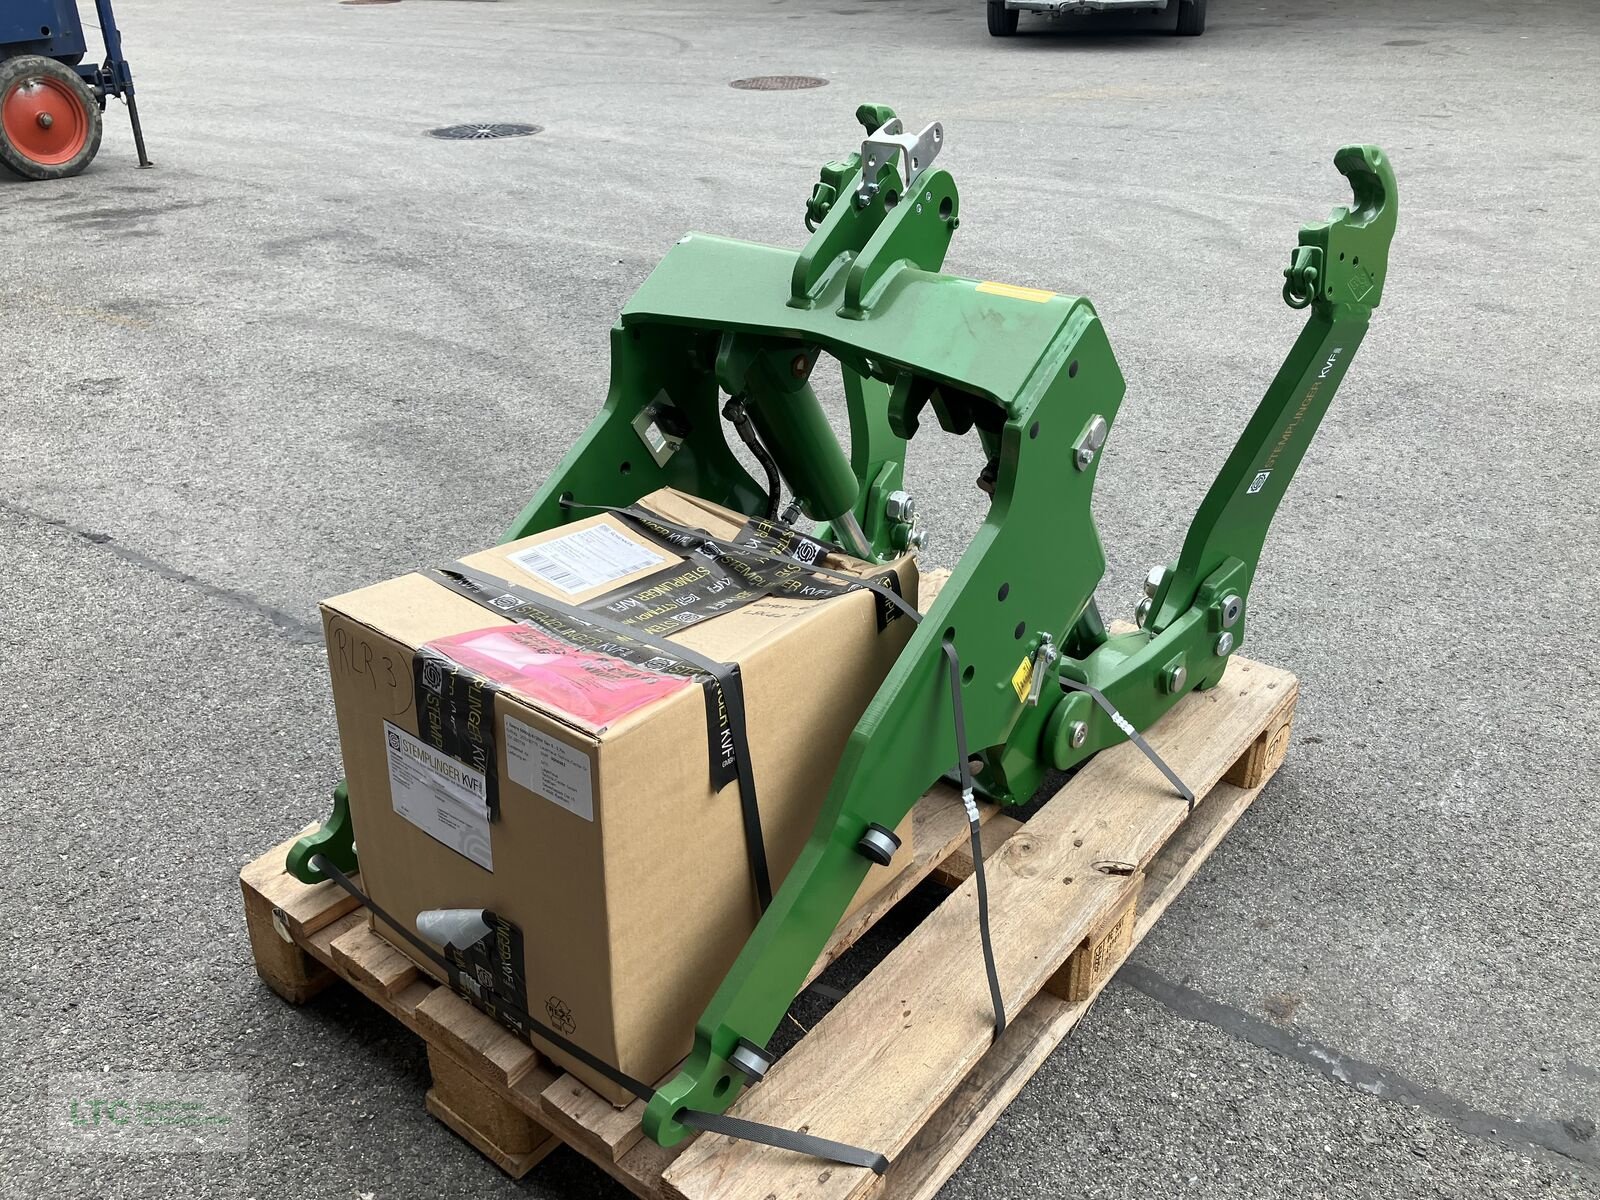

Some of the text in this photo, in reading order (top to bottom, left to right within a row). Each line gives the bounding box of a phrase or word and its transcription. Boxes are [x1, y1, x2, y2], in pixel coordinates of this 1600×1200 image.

[1264, 353, 1338, 468] STEMPLINGER KVF
[634, 566, 711, 601] STEMPLINGER
[515, 606, 604, 647] STEMPLINGER
[720, 728, 735, 758] KVF
[402, 738, 461, 783] STEMPLINGER
[461, 772, 480, 791] KVF
